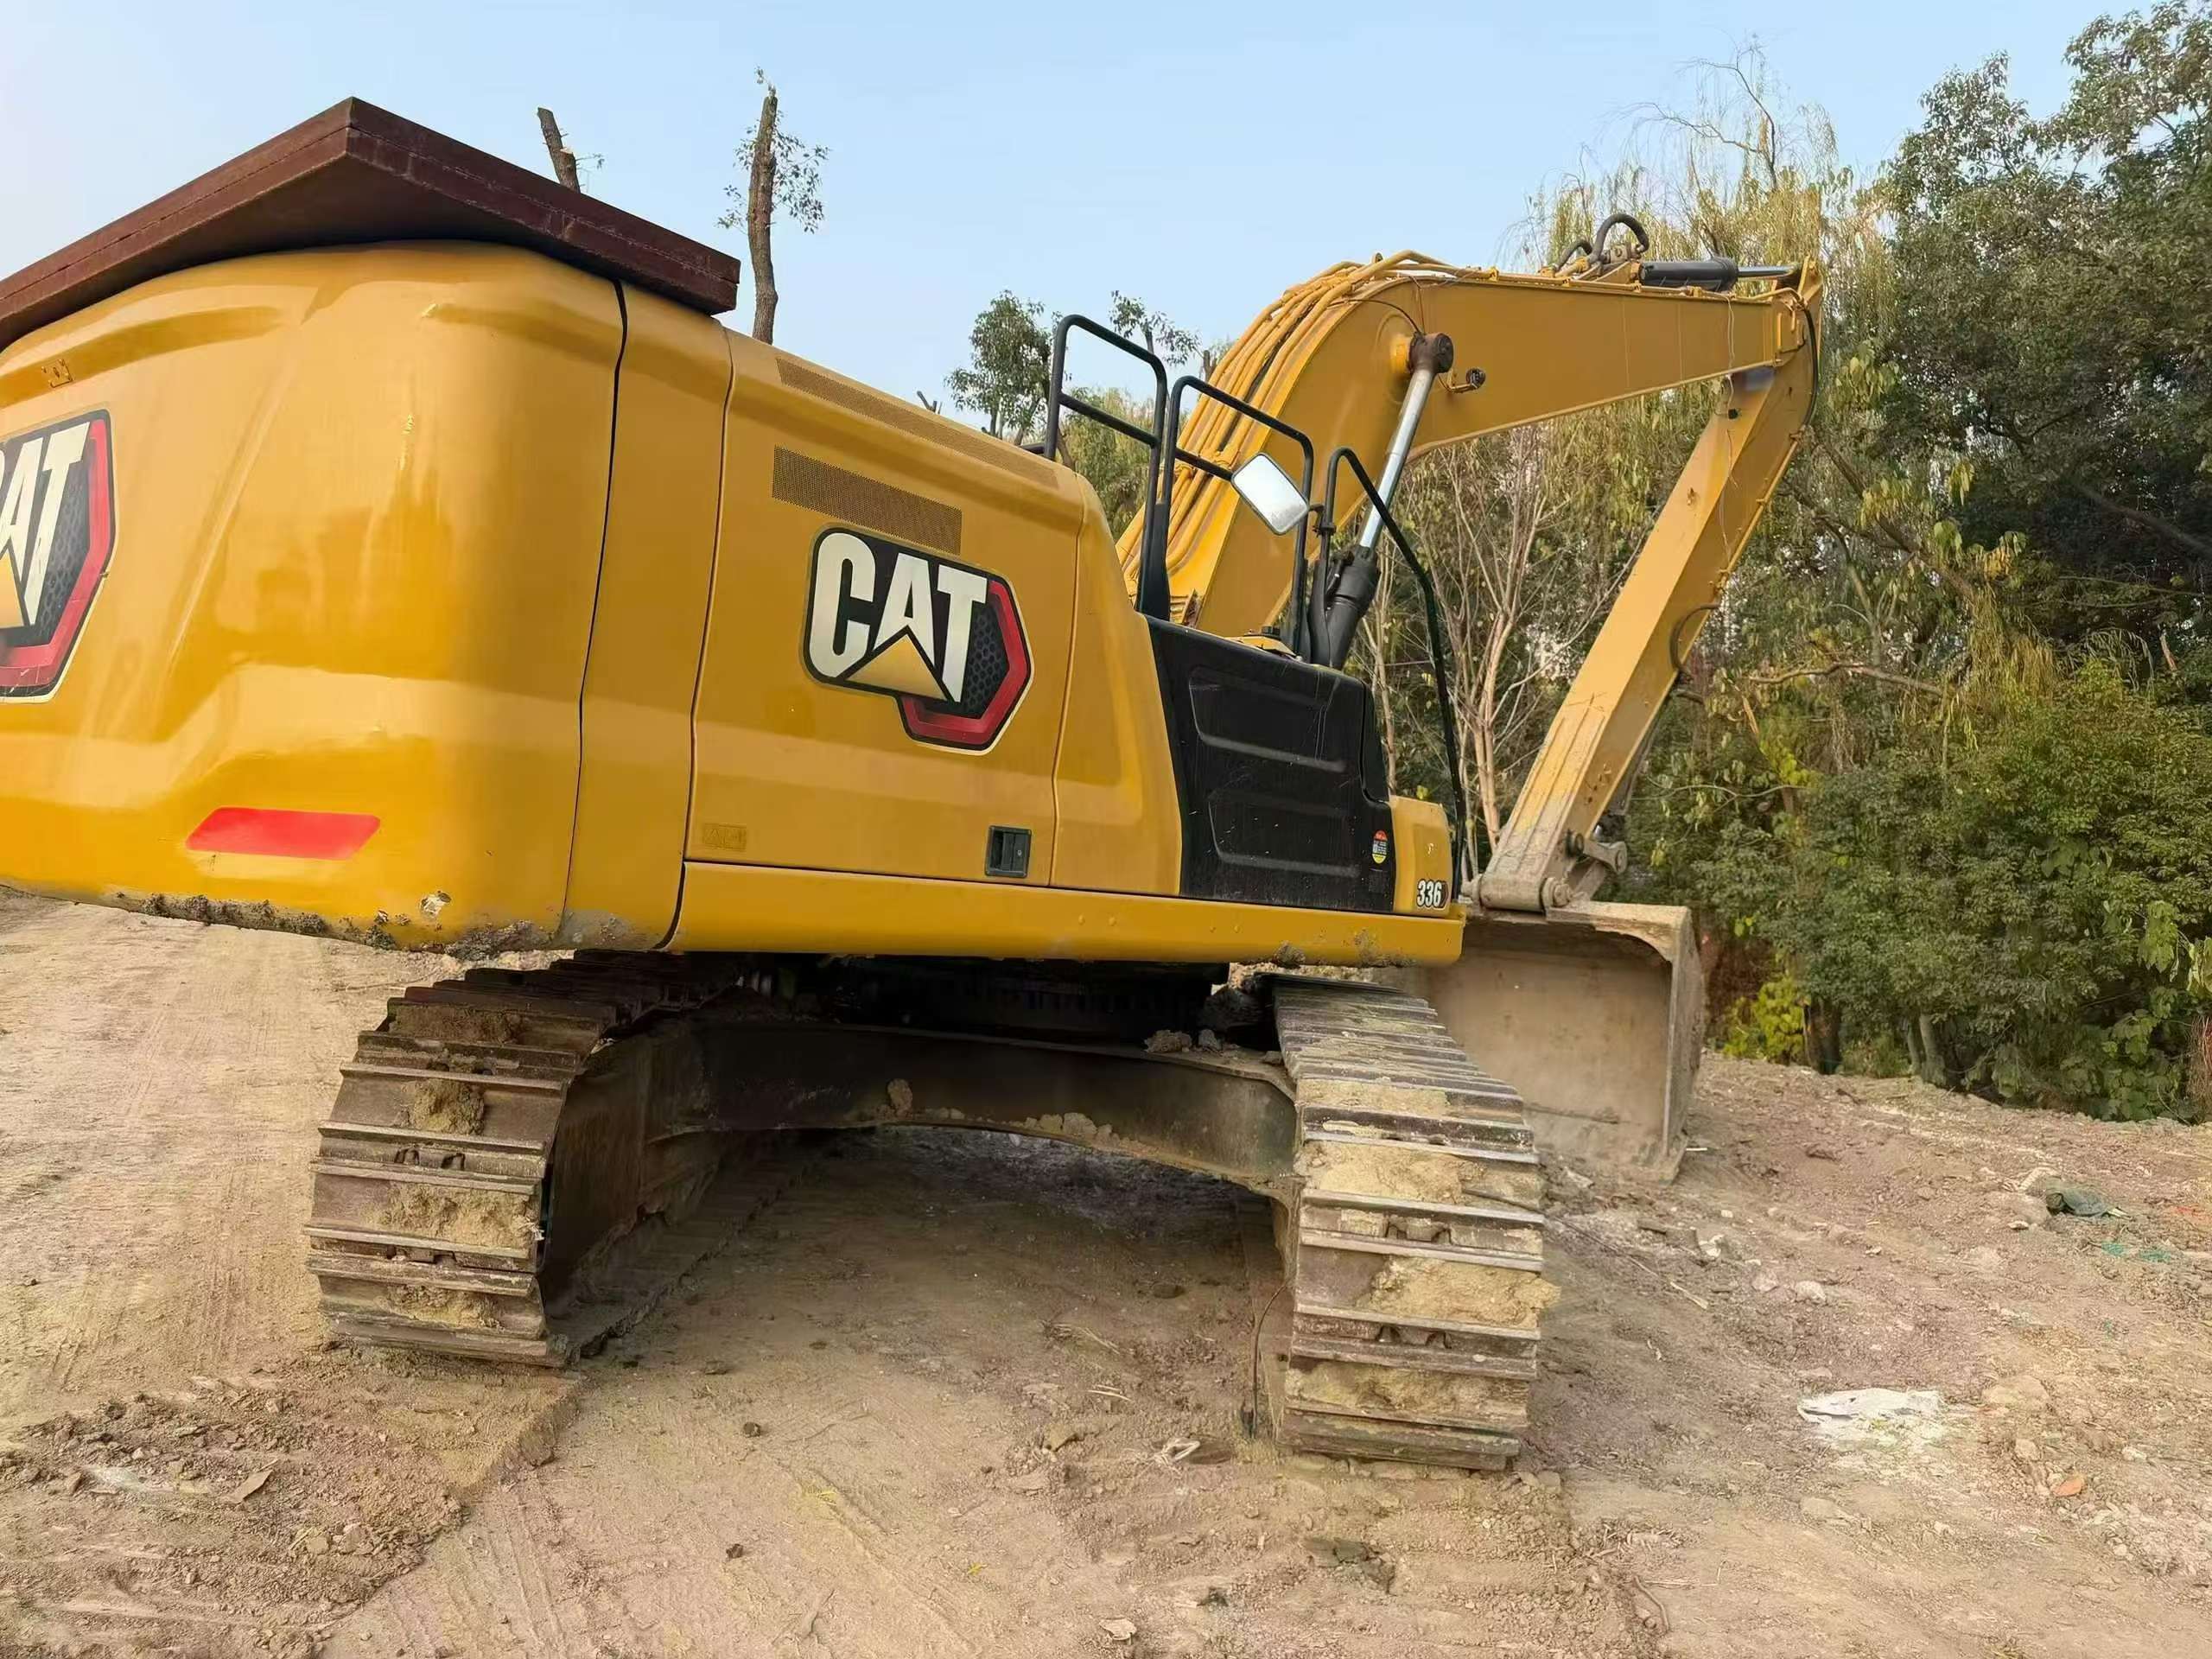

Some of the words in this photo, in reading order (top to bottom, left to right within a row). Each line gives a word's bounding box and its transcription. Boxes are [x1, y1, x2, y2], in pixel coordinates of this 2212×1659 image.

[0, 421, 90, 628] AT
[809, 532, 988, 702] CAT
[1417, 880, 1442, 906] 336
